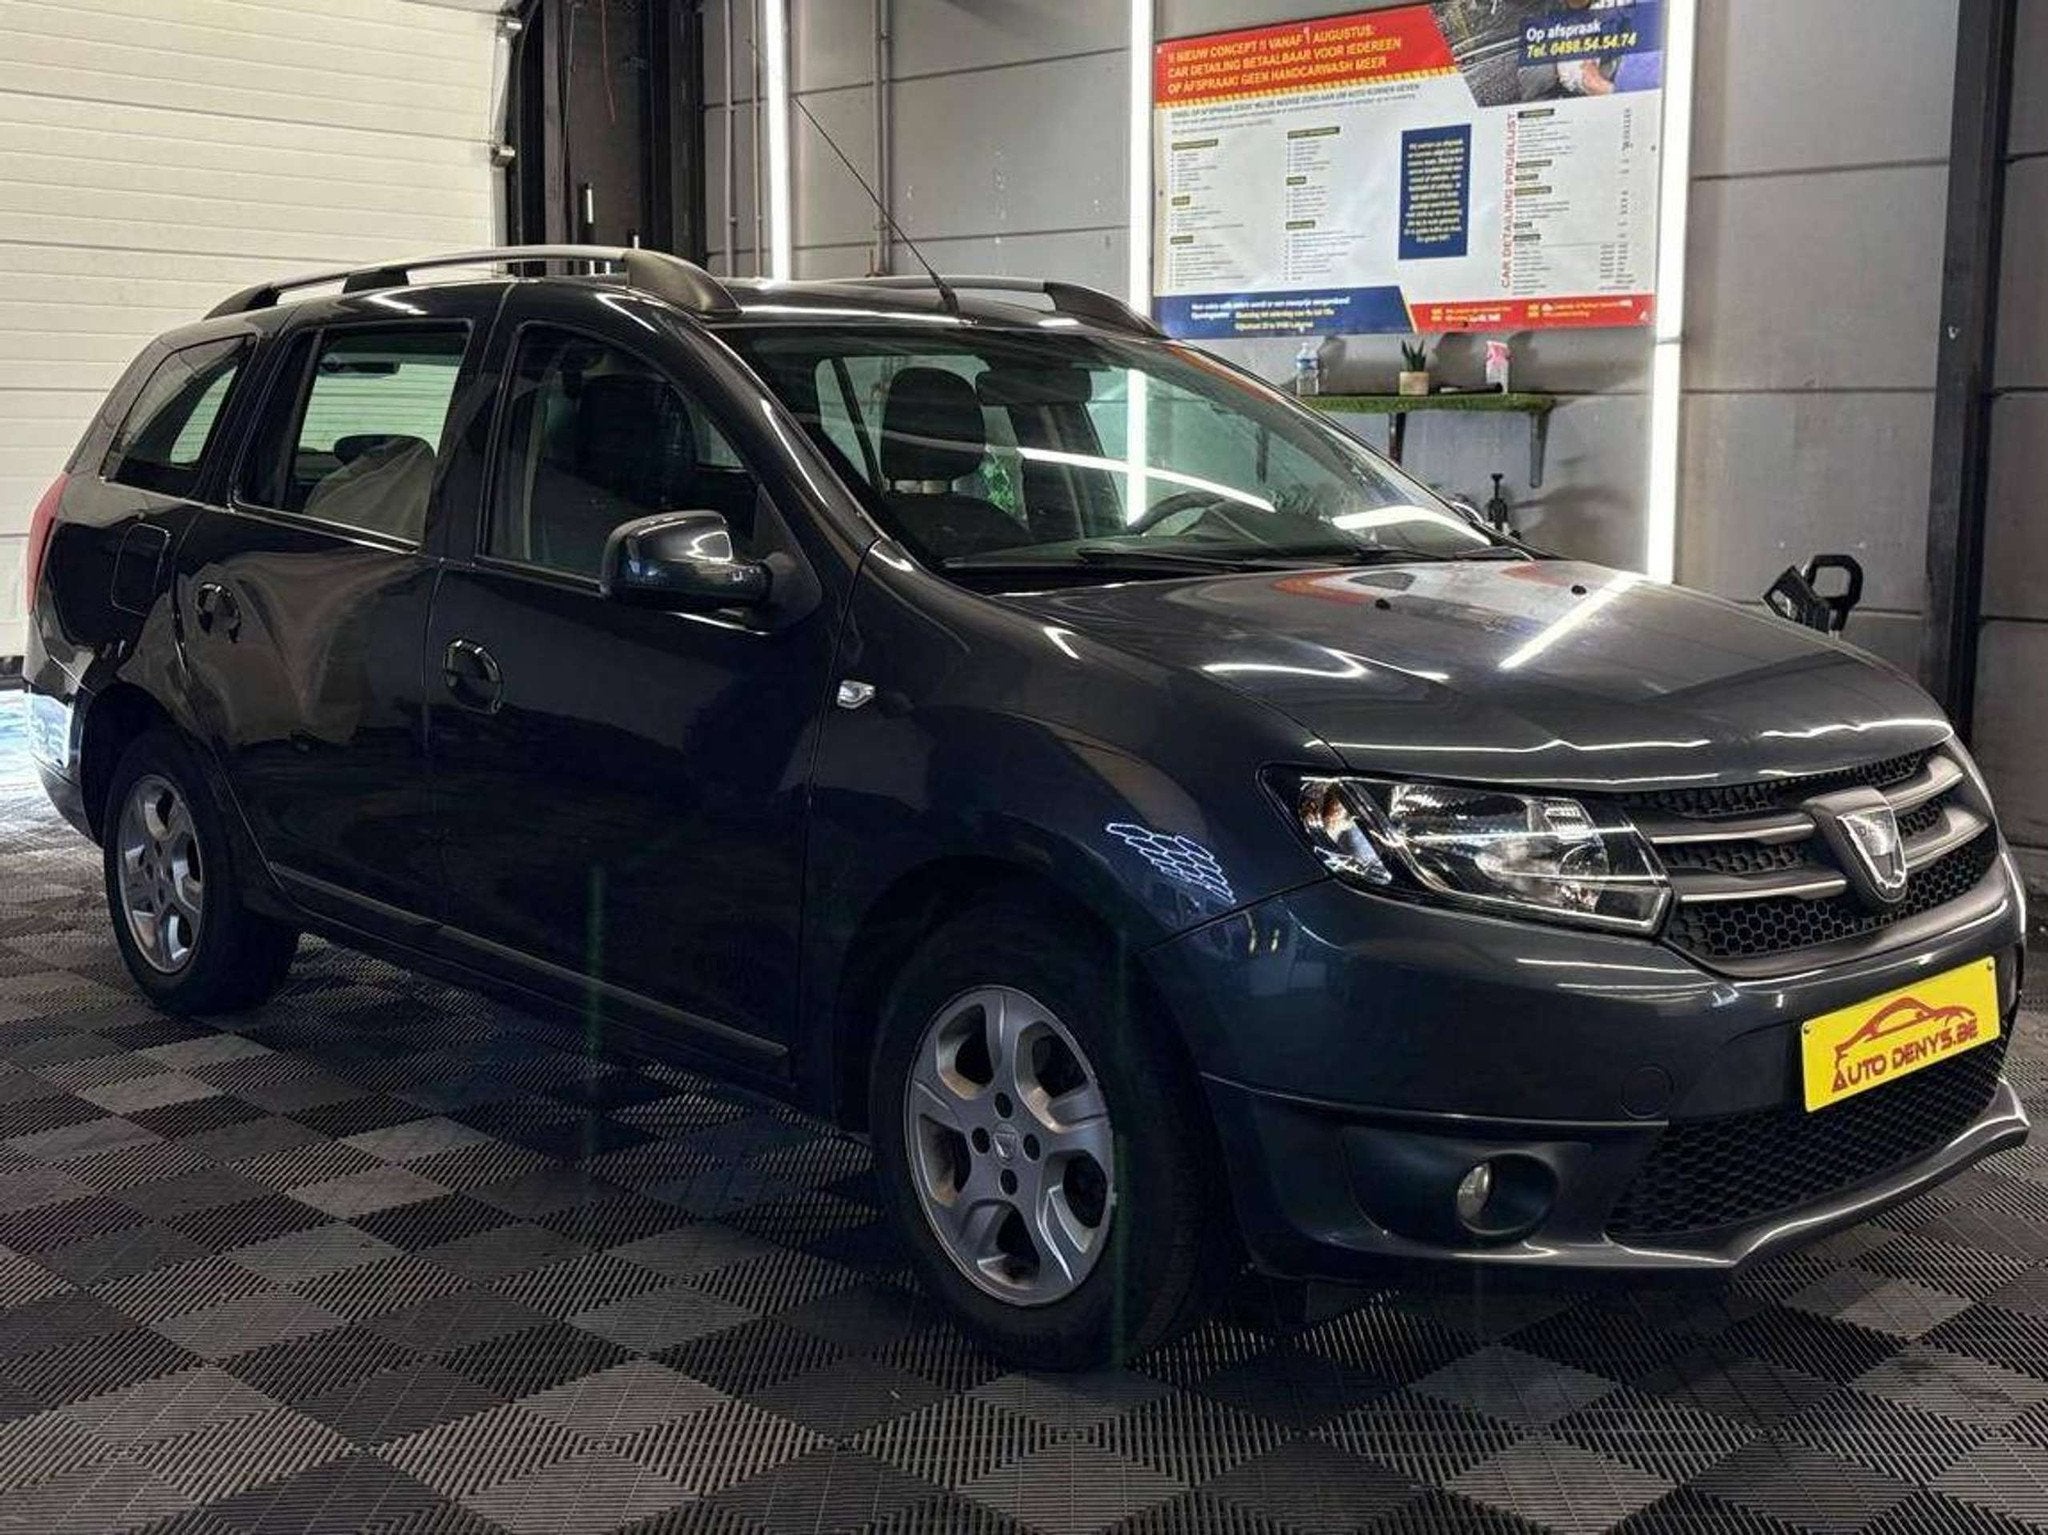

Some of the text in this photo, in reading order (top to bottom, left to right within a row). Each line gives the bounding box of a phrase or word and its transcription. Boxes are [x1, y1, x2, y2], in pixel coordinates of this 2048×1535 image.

[1176, 47, 1208, 61] NIEUW
[1210, 41, 1257, 58] CONCEPT
[1269, 33, 1303, 49] VANAF
[1526, 19, 1601, 43] Op afspraak
[1167, 37, 1401, 78] CAR DETAILING BETAALBAAR VOOR IEDEREEN
[1527, 43, 1546, 58] Tel.
[1167, 83, 1182, 94] OP
[1241, 71, 1270, 85] GEEN
[1271, 60, 1354, 80] HANDCARWASH
[1355, 55, 1387, 70] MEER
[1503, 188, 1514, 257] DETAILING
[1501, 260, 1511, 288] CAR
[1831, 1018, 1978, 1093] AUTO DENYS.BE
